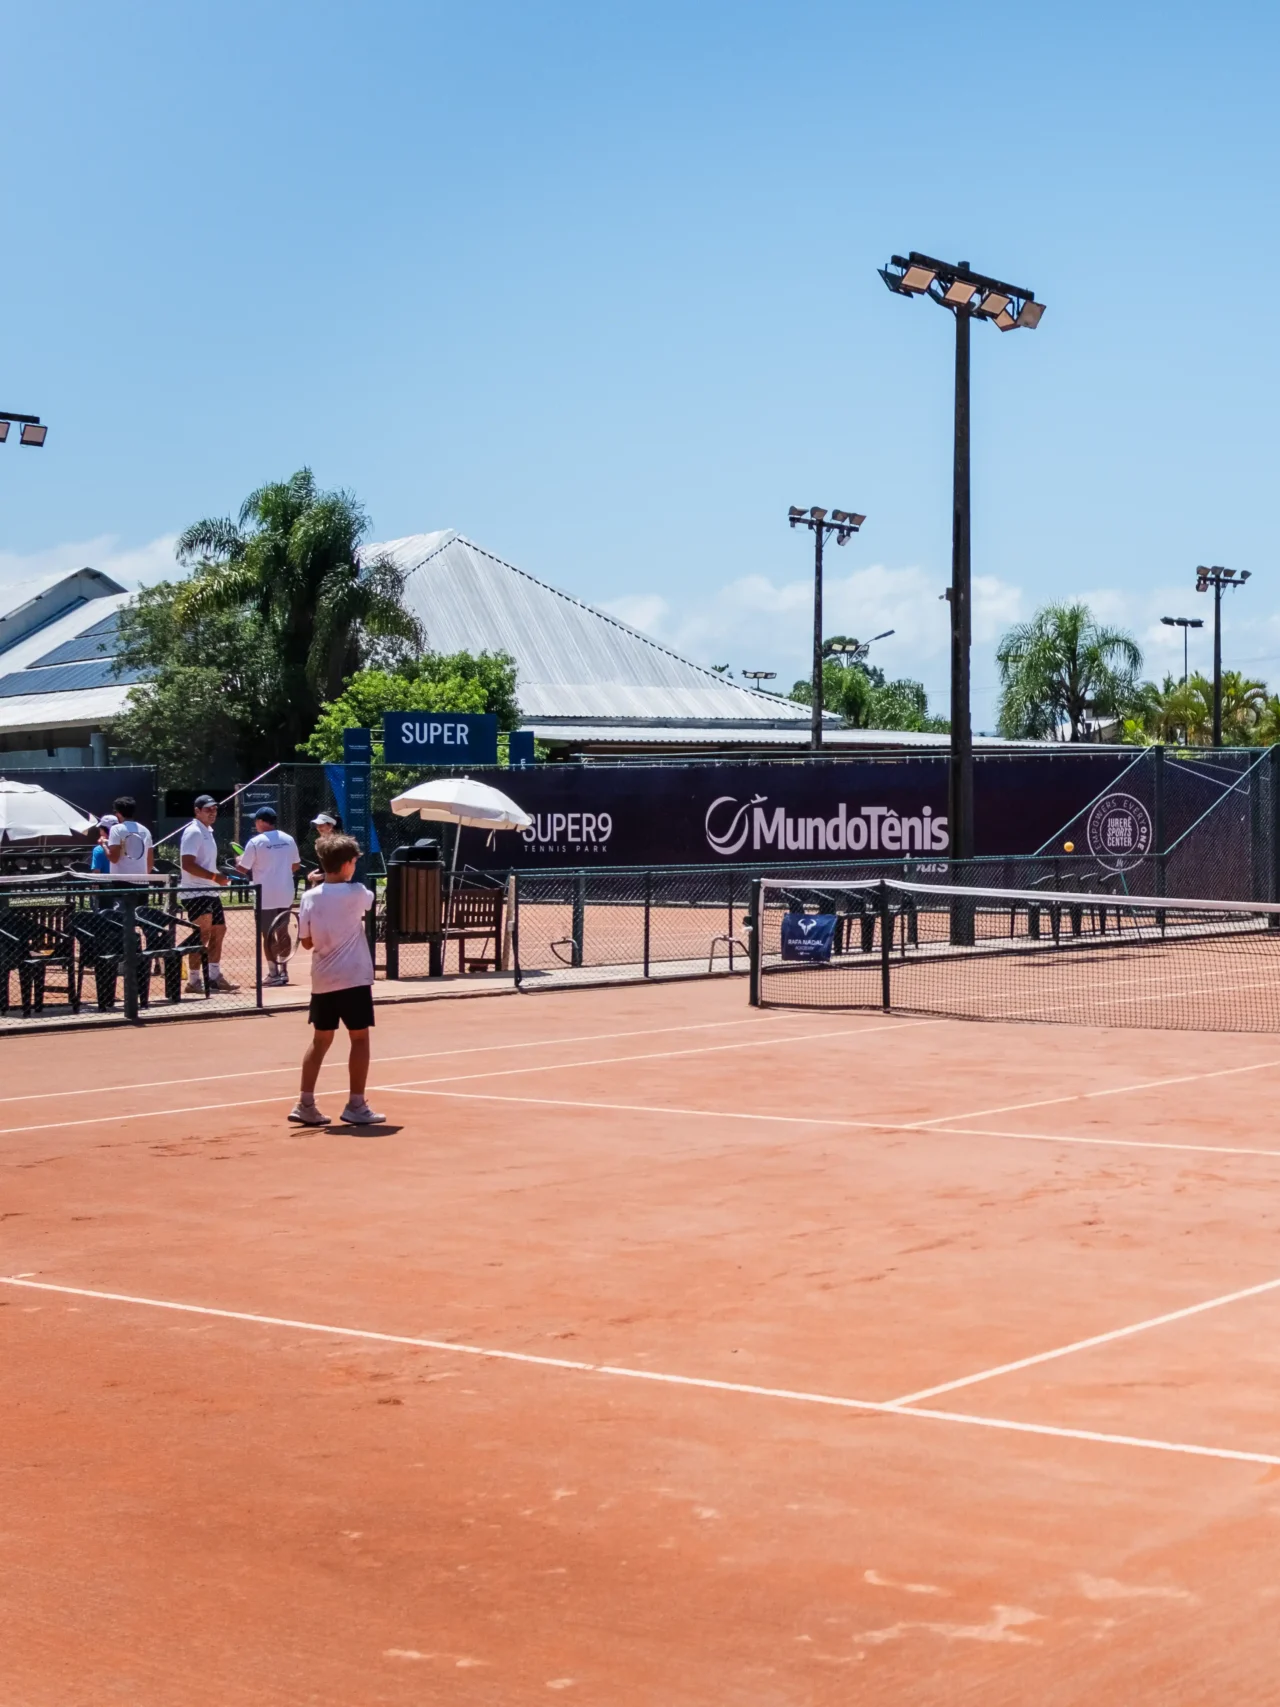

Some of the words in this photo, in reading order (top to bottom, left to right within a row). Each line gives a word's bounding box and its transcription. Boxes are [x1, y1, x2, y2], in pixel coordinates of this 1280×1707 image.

[401, 722, 469, 745] SUPER
[522, 812, 612, 842] SUPER9
[753, 803, 949, 850] MundoTênis
[1107, 827, 1132, 837] SPORTS
[1107, 836, 1132, 847] CENTER
[903, 853, 949, 872] turs
